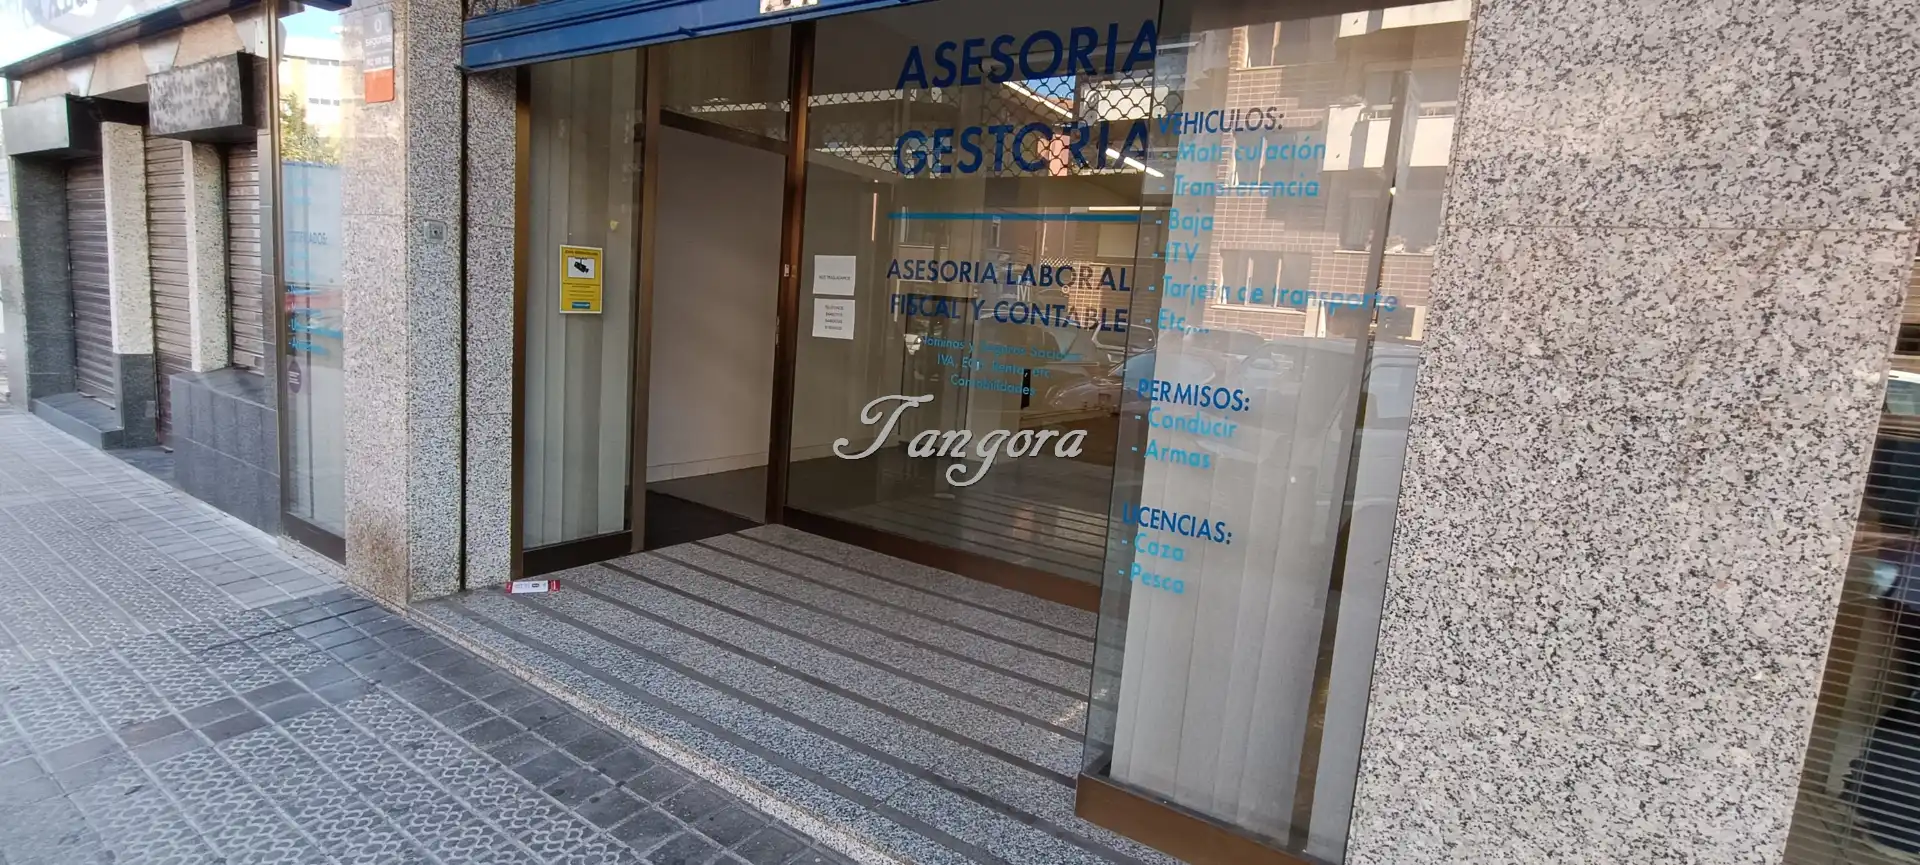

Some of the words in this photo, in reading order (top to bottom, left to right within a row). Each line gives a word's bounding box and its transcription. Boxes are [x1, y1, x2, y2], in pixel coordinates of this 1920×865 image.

[896, 19, 1157, 91] ASESORIA
[1158, 107, 1285, 135] VEHICULOS:
[895, 119, 1149, 176] GESTORIA
[1168, 208, 1214, 236] Baja
[1164, 241, 1199, 263] ITV
[887, 259, 997, 285] ASESORIA
[1006, 263, 1131, 291] LABORAL
[1163, 275, 1231, 305] Tarjeta
[890, 293, 960, 319] FISCAL
[970, 299, 985, 320] Y
[994, 300, 1129, 332] CONTABLE
[1138, 378, 1250, 411] PERMISOS:
[1148, 407, 1238, 438] Conducir
[1144, 439, 1211, 469] Armas
[1122, 502, 1232, 544] LICENCIAS:
[1134, 533, 1184, 562] Caza
[1130, 562, 1184, 594] Pesca
